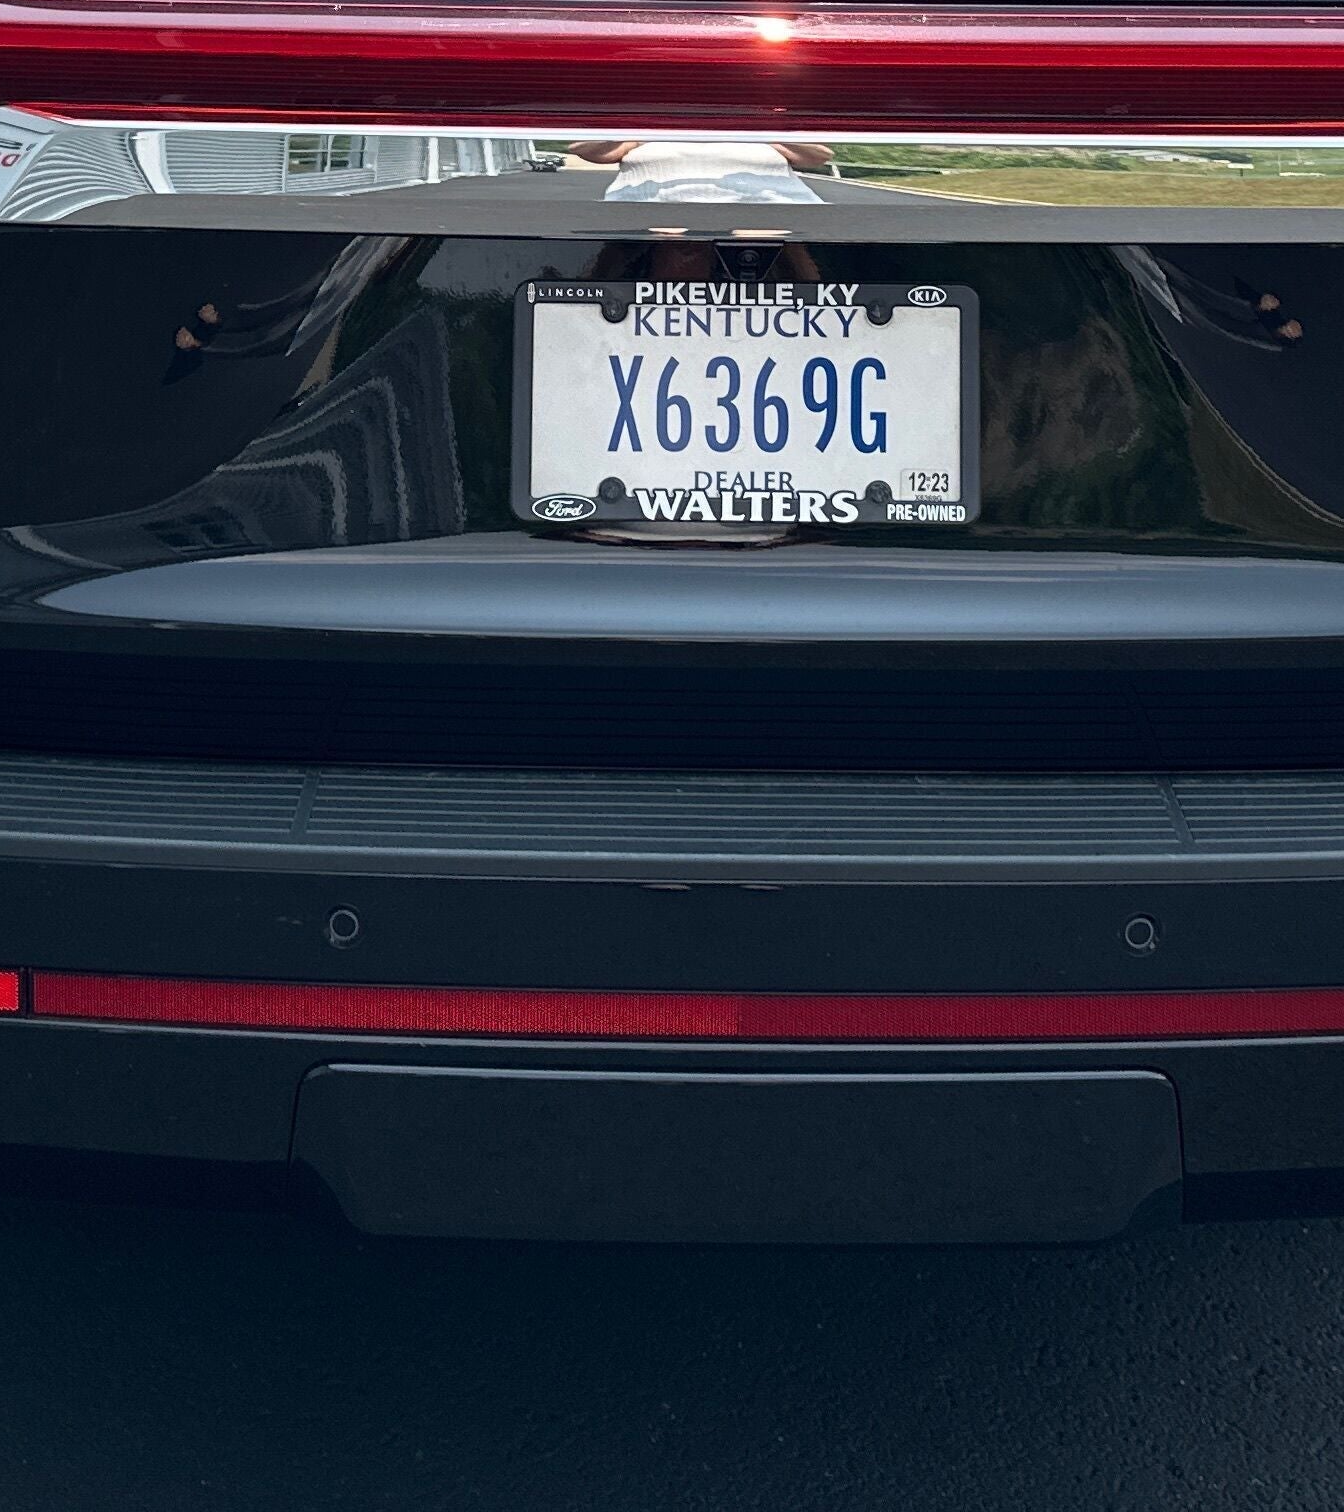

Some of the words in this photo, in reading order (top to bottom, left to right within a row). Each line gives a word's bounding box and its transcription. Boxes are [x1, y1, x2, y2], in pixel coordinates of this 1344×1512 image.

[538, 288, 604, 298] LINCOLN
[634, 281, 804, 310] PIKEVILLE,
[816, 283, 860, 306] KY
[912, 289, 942, 303] KIA
[633, 306, 859, 338] KENTUCKY
[607, 354, 888, 455] X6369G
[693, 471, 794, 492] DEALER
[544, 499, 584, 519] Ford
[634, 490, 860, 524] WALTERS
[886, 503, 966, 522] PRE-OWNED
